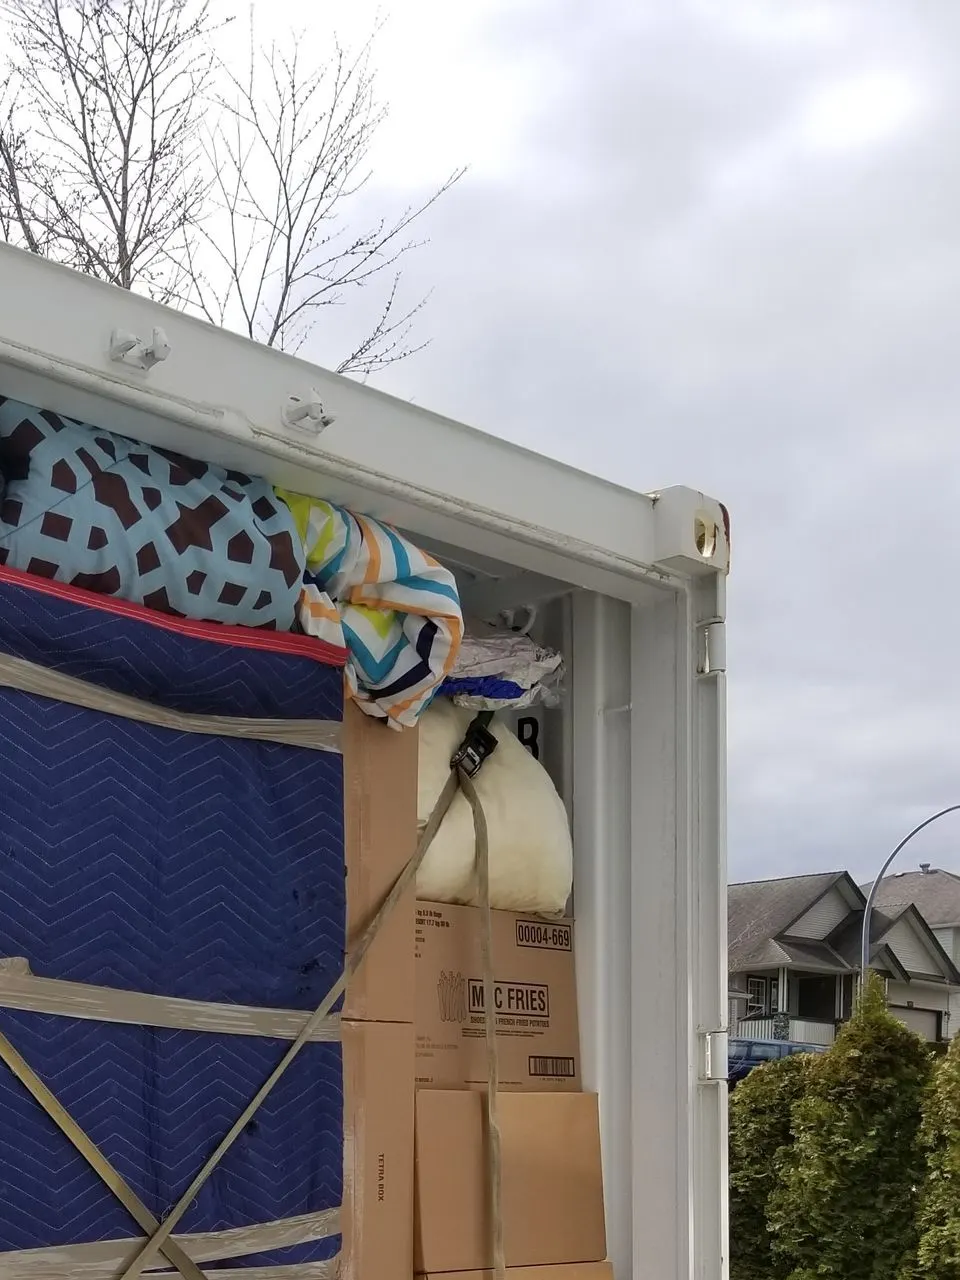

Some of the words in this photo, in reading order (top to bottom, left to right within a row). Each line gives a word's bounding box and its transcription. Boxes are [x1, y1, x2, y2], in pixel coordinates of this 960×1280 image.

[517, 924, 570, 947] 00004-669
[471, 985, 503, 1009] MC
[507, 987, 546, 1012] FRIES
